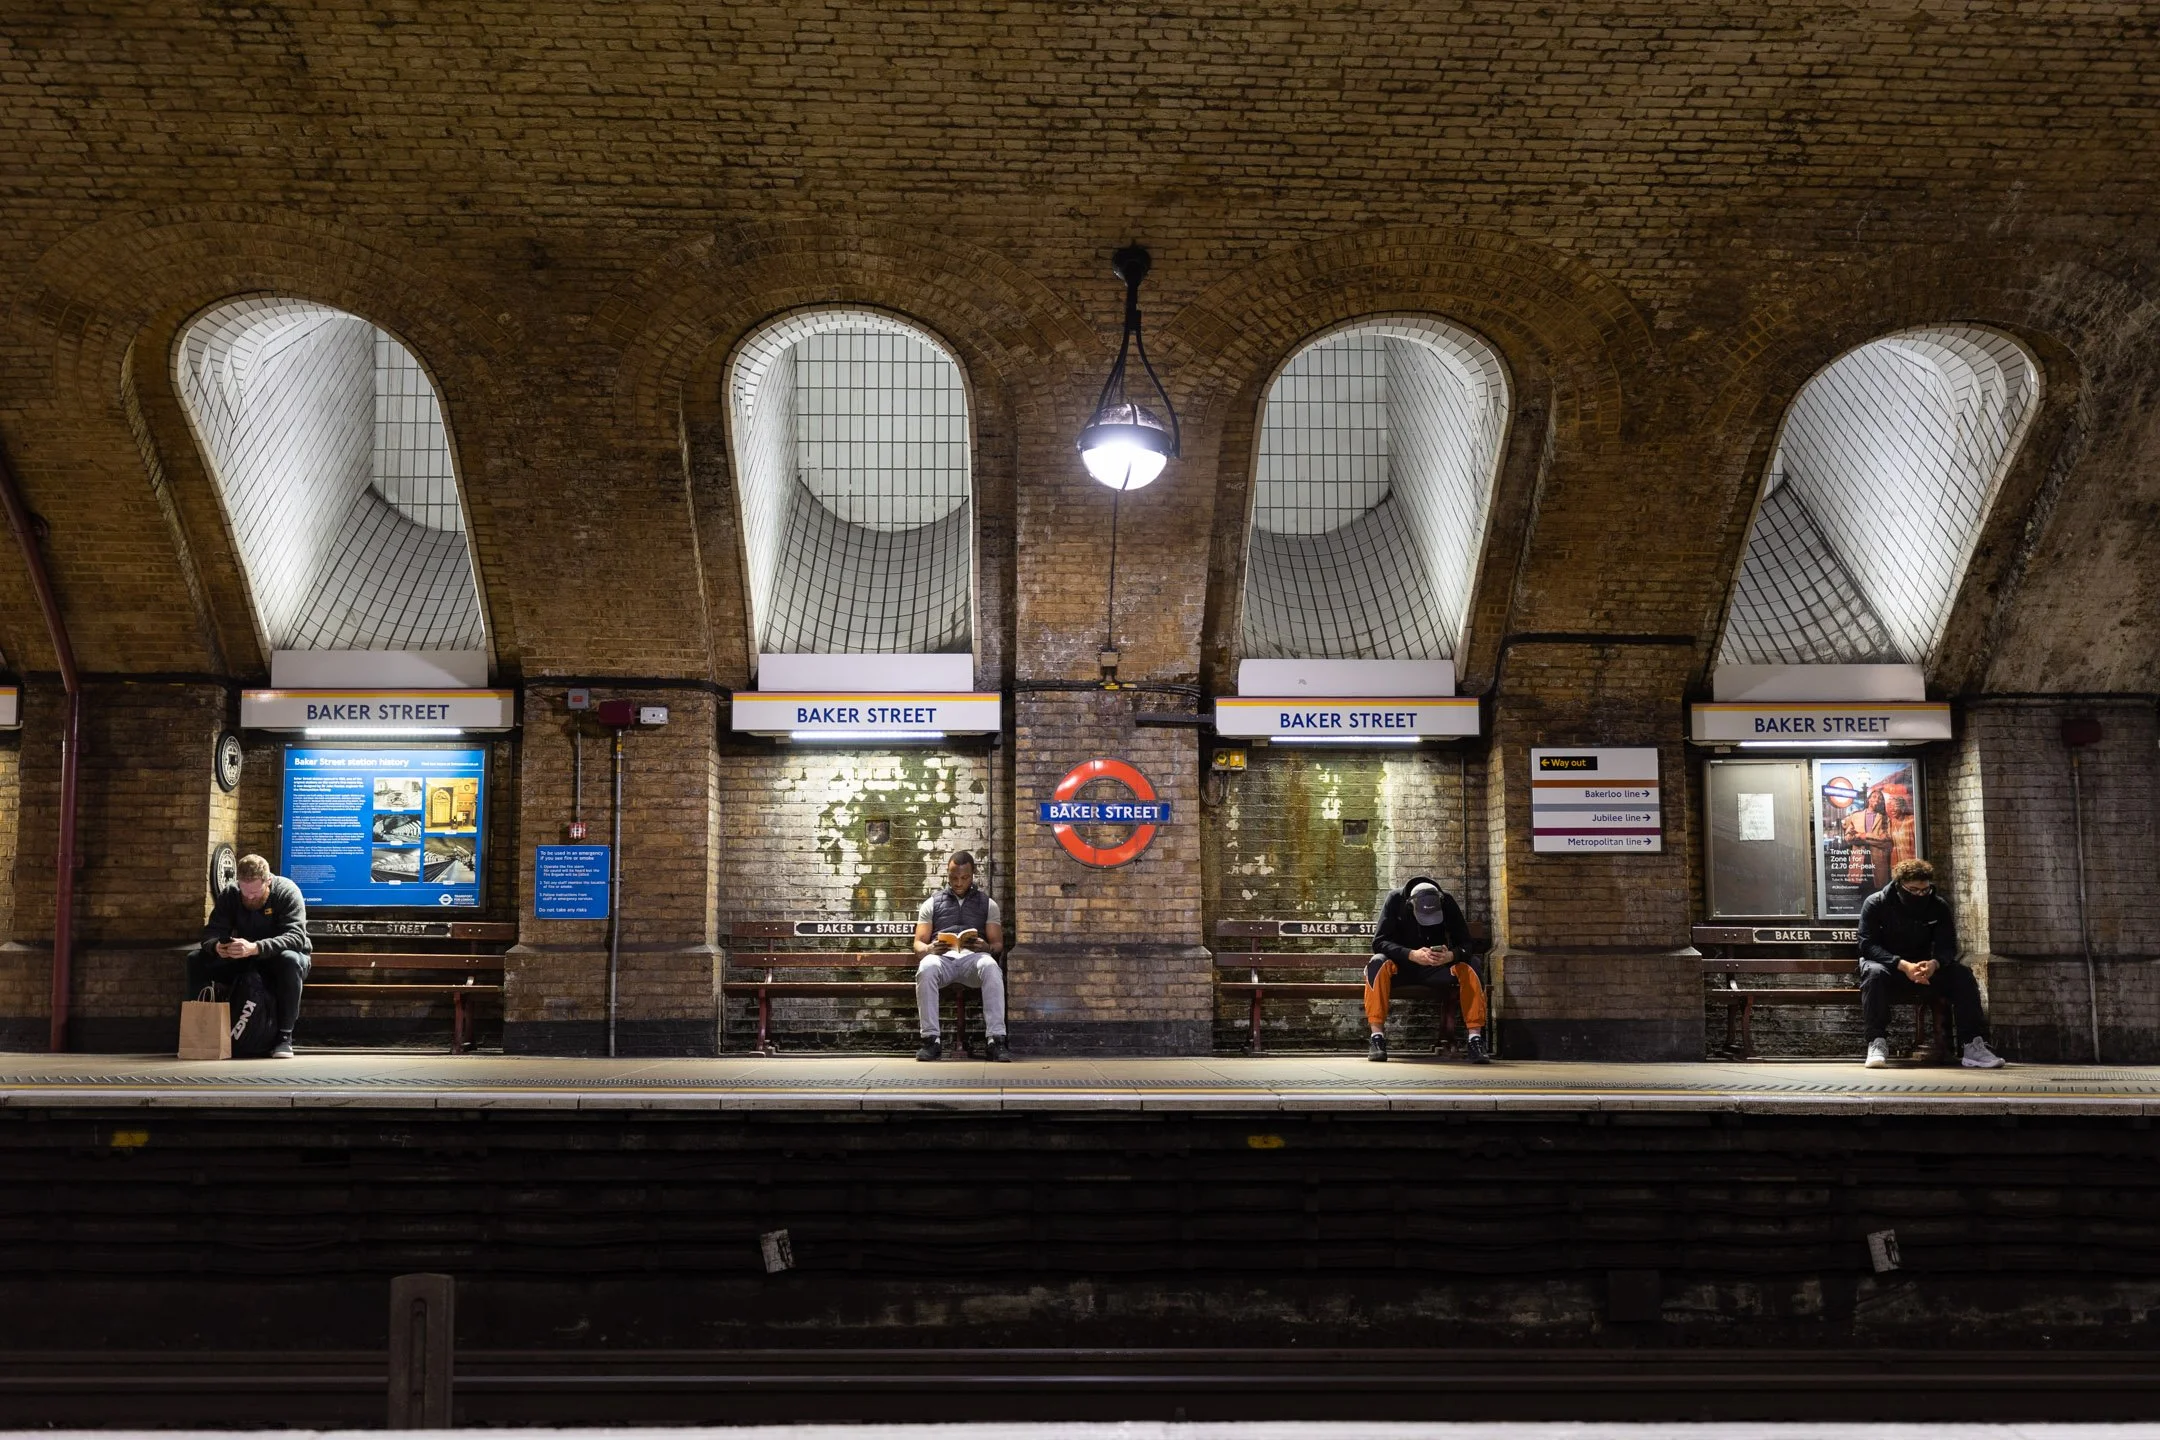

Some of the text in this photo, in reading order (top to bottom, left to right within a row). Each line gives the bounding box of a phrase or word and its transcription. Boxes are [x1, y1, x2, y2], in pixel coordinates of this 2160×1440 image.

[307, 704, 450, 720] BAKER STREET
[797, 707, 937, 723] BAKER STREET
[1280, 713, 1417, 728] BAKER STREET
[1754, 717, 1890, 733] BAKER STREET
[294, 757, 318, 766] Baker
[319, 757, 346, 766] Street
[347, 757, 377, 766] station
[379, 757, 410, 768] history
[1551, 759, 1587, 768] Way out
[1585, 790, 1640, 798] Bakerloo line
[1050, 806, 1160, 819] BAKER STREET
[1592, 814, 1641, 822] Jubilee line
[1568, 838, 1642, 847] Metropolitan line
[326, 924, 427, 934] BAKER STREET
[817, 924, 915, 934] BAKER STREET
[1301, 924, 1338, 933] BAKER
[1775, 931, 1857, 940] BAKER STRE
